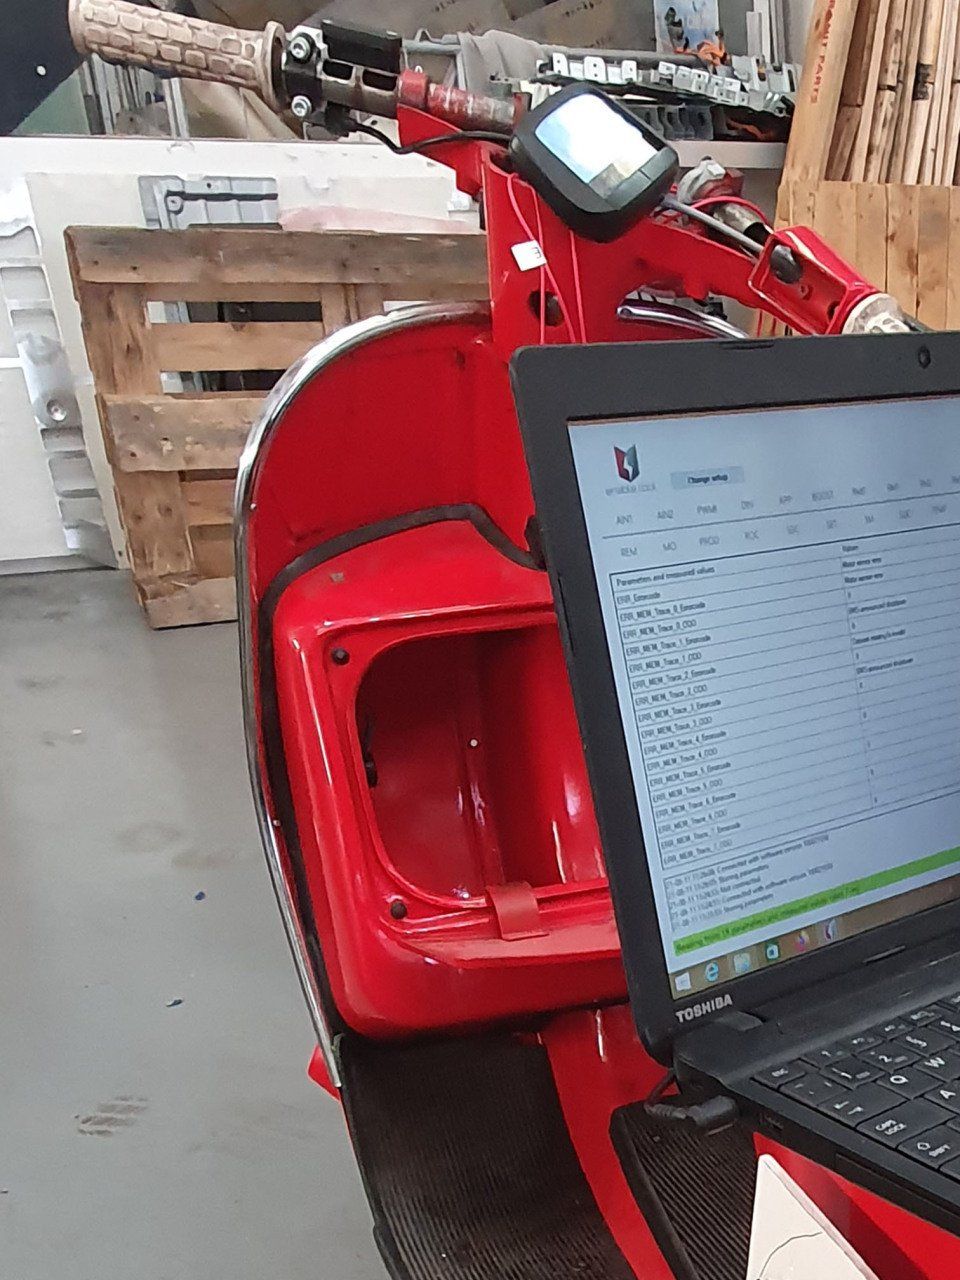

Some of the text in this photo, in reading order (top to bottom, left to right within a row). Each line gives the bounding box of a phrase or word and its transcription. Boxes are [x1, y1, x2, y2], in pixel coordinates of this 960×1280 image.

[675, 994, 734, 1024] TOSHIBA
[890, 1074, 909, 1085] Q
[924, 1056, 946, 1068] W
[939, 1089, 956, 1099] A
